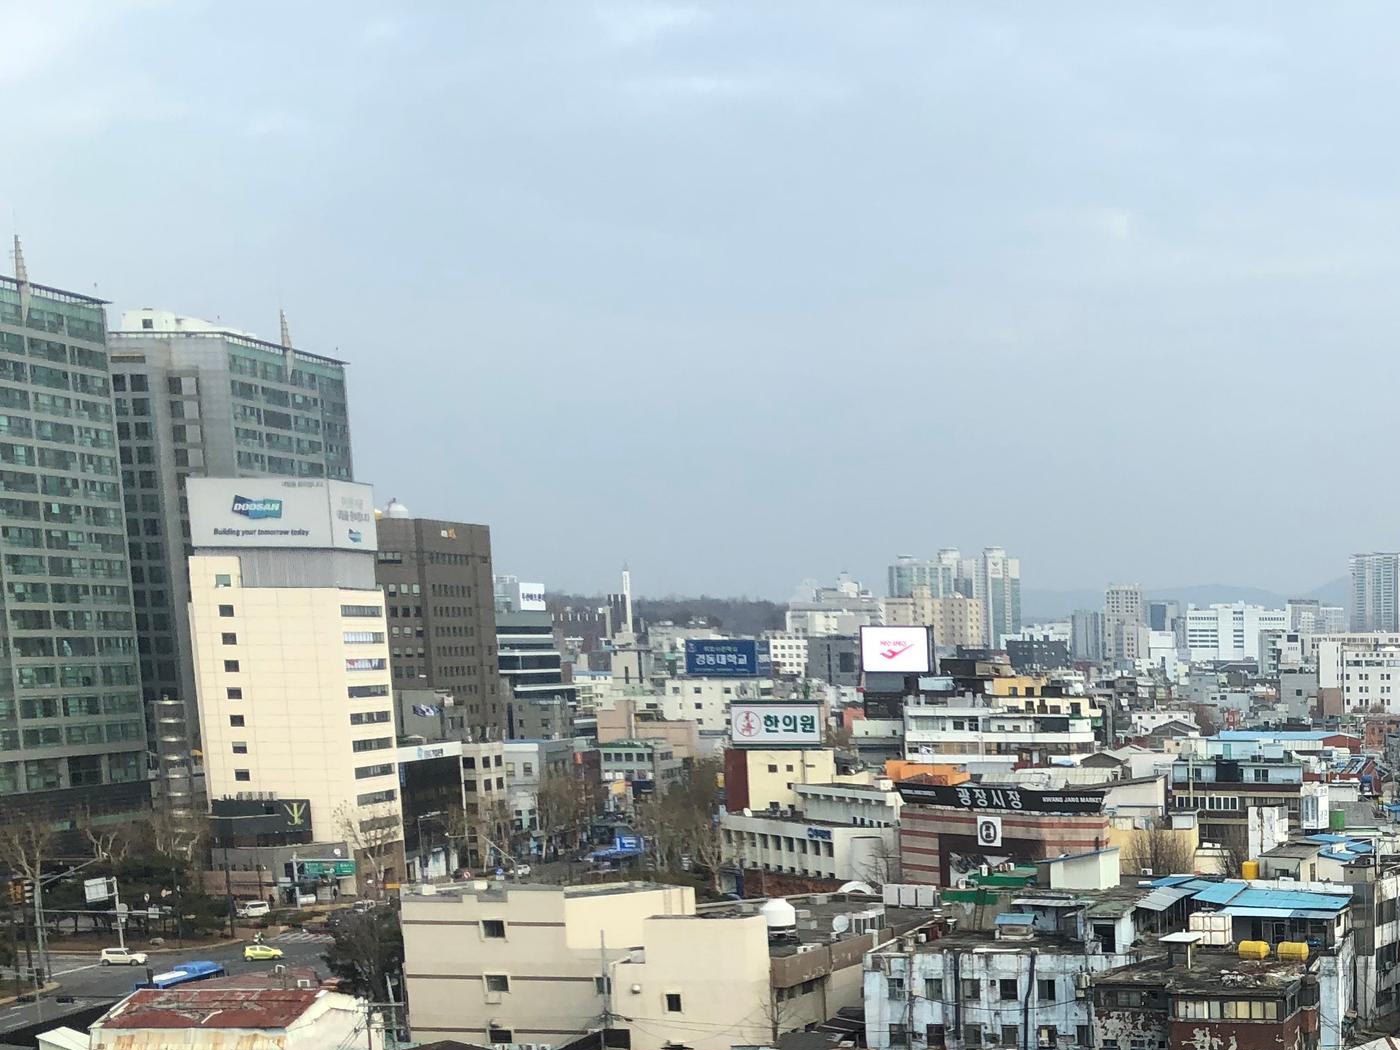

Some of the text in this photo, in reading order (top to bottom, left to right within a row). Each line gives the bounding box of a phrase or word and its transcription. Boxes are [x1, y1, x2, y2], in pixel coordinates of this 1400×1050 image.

[233, 502, 280, 512] DOOSAN
[213, 527, 309, 537] Building your tomorrow today
[695, 653, 747, 666] 경동대학교
[763, 714, 816, 734] 한의원
[955, 787, 1023, 809] 광장시장
